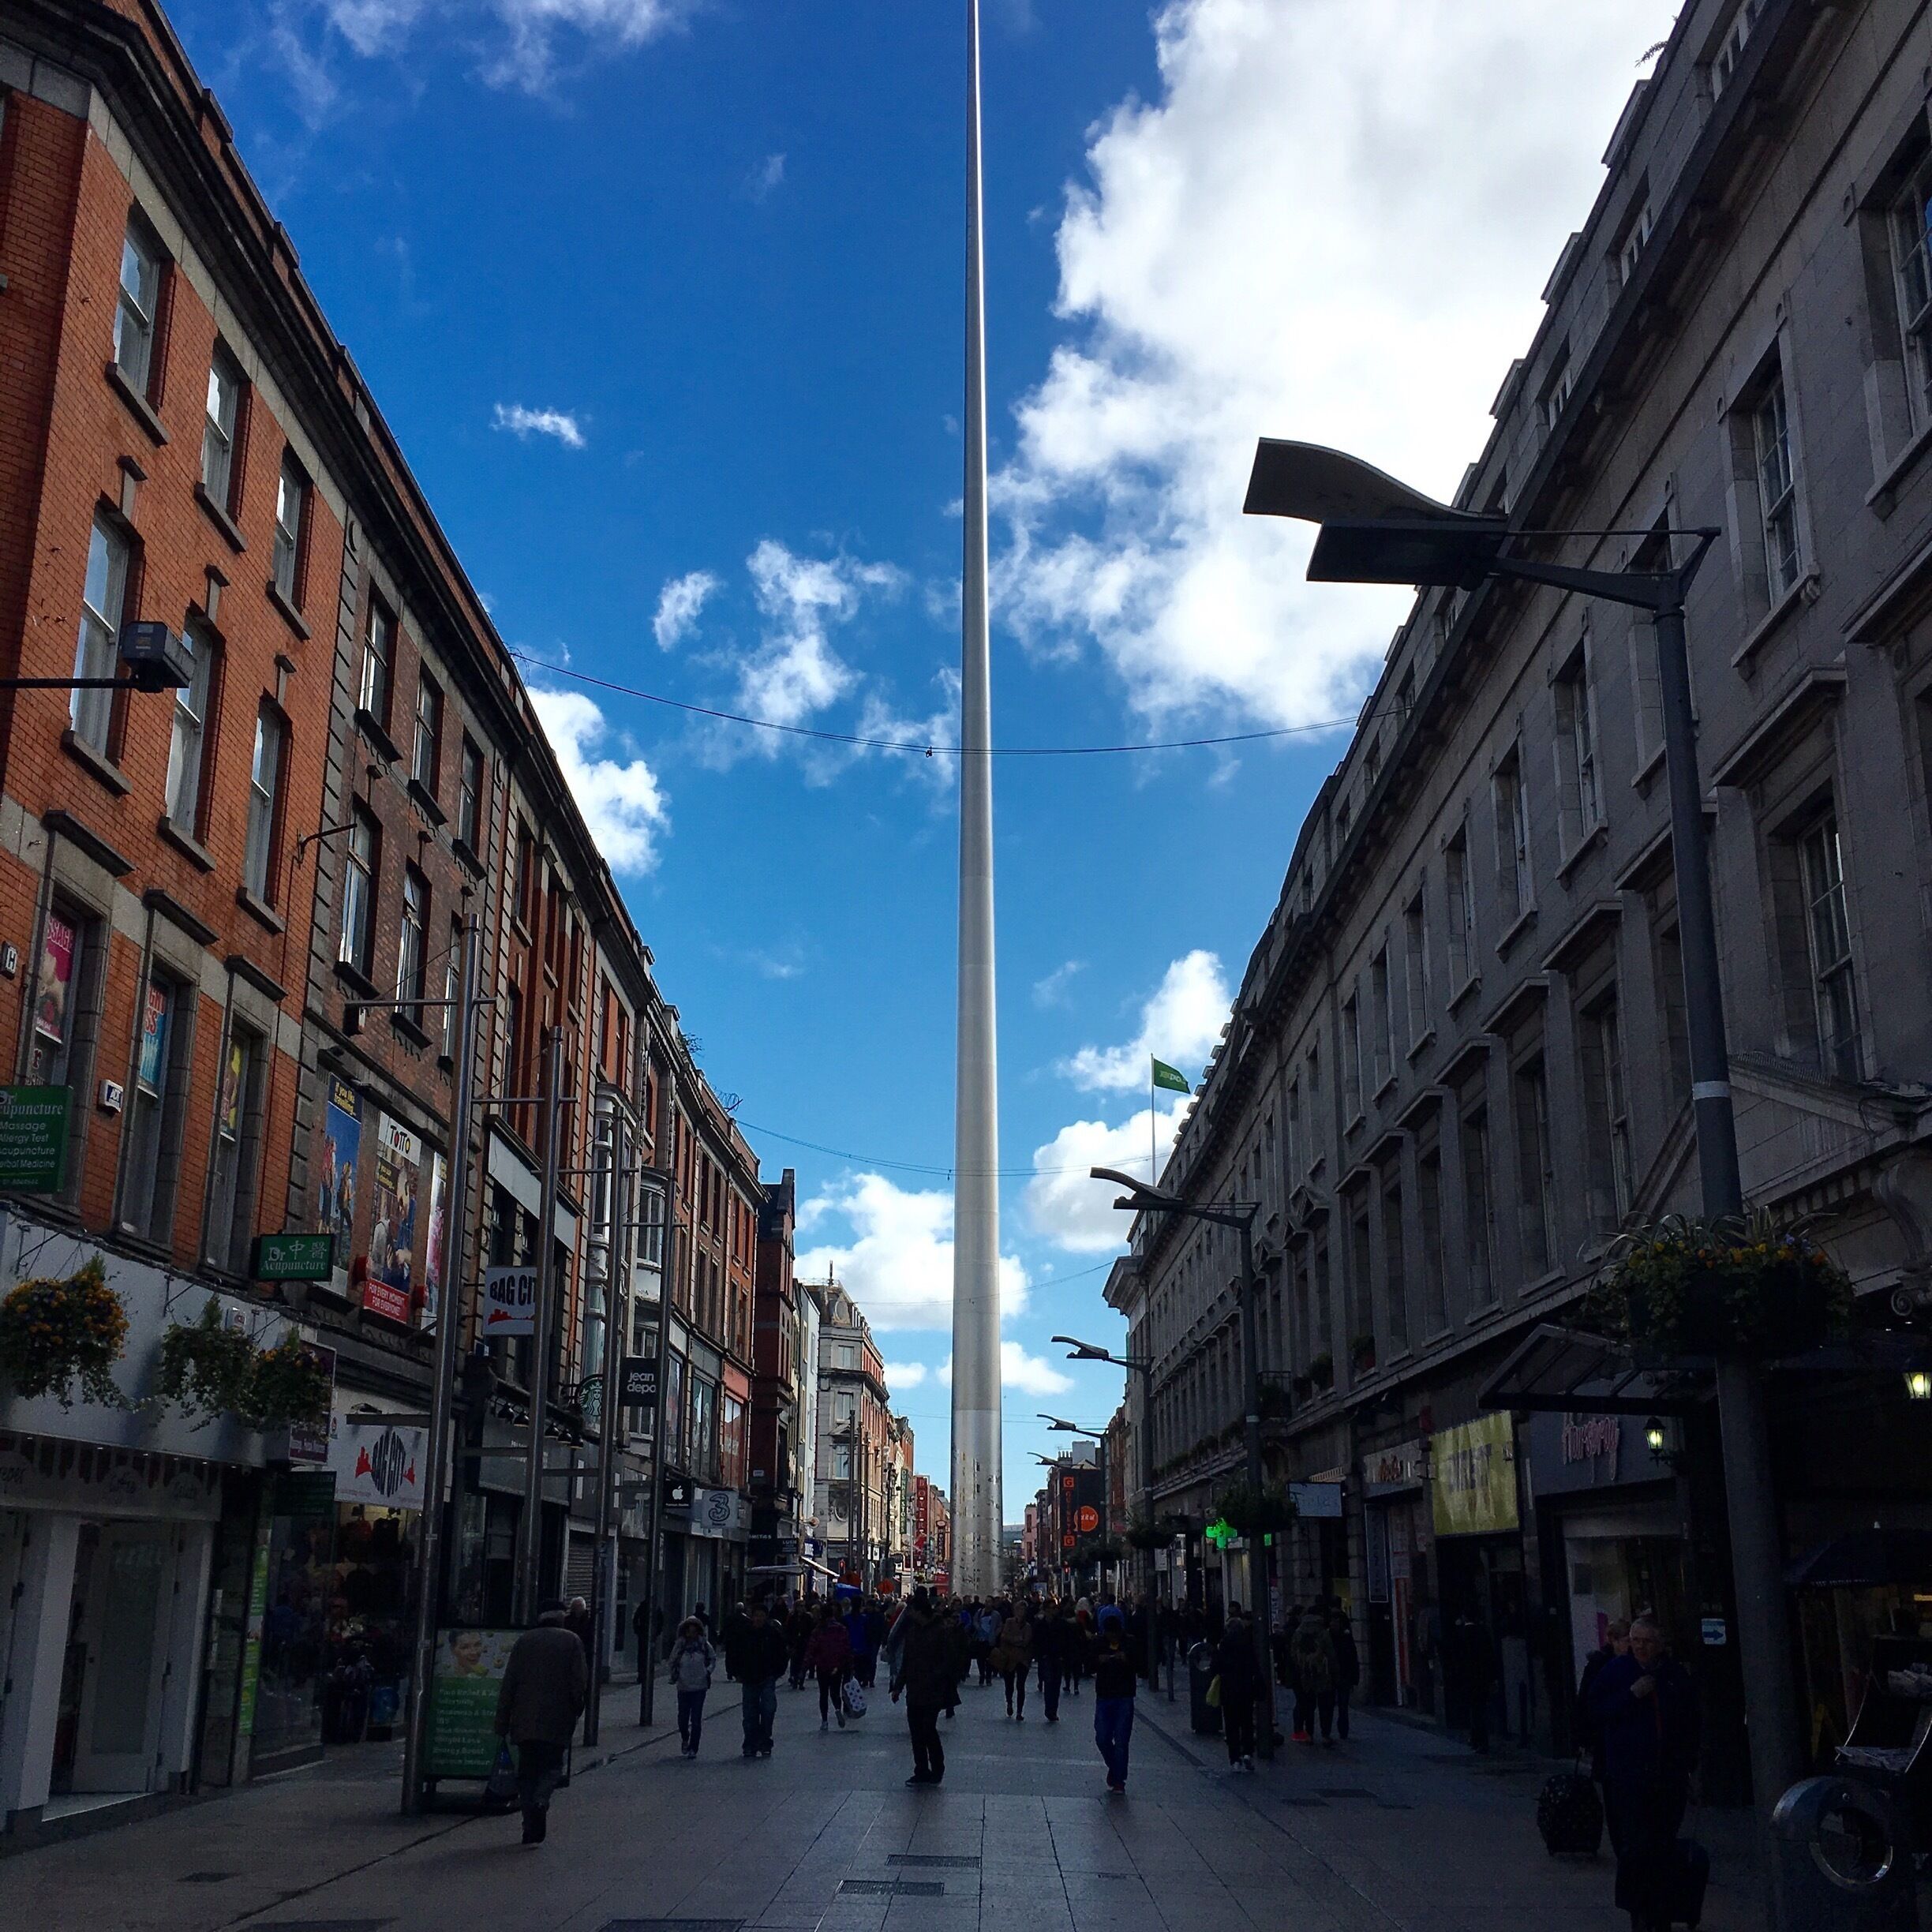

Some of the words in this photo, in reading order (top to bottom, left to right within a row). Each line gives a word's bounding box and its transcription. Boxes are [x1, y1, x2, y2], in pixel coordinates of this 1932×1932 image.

[0, 1121, 47, 1132] Massage
[32, 1133, 49, 1142] Test
[391, 1125, 411, 1155] TOTTO
[0, 1146, 55, 1156] cupuncture
[21, 1159, 55, 1168] Medicine
[261, 1260, 326, 1274] Acupuncture
[490, 1275, 515, 1305] BAG
[627, 1372, 654, 1382] jean
[709, 1493, 730, 1522] 3
